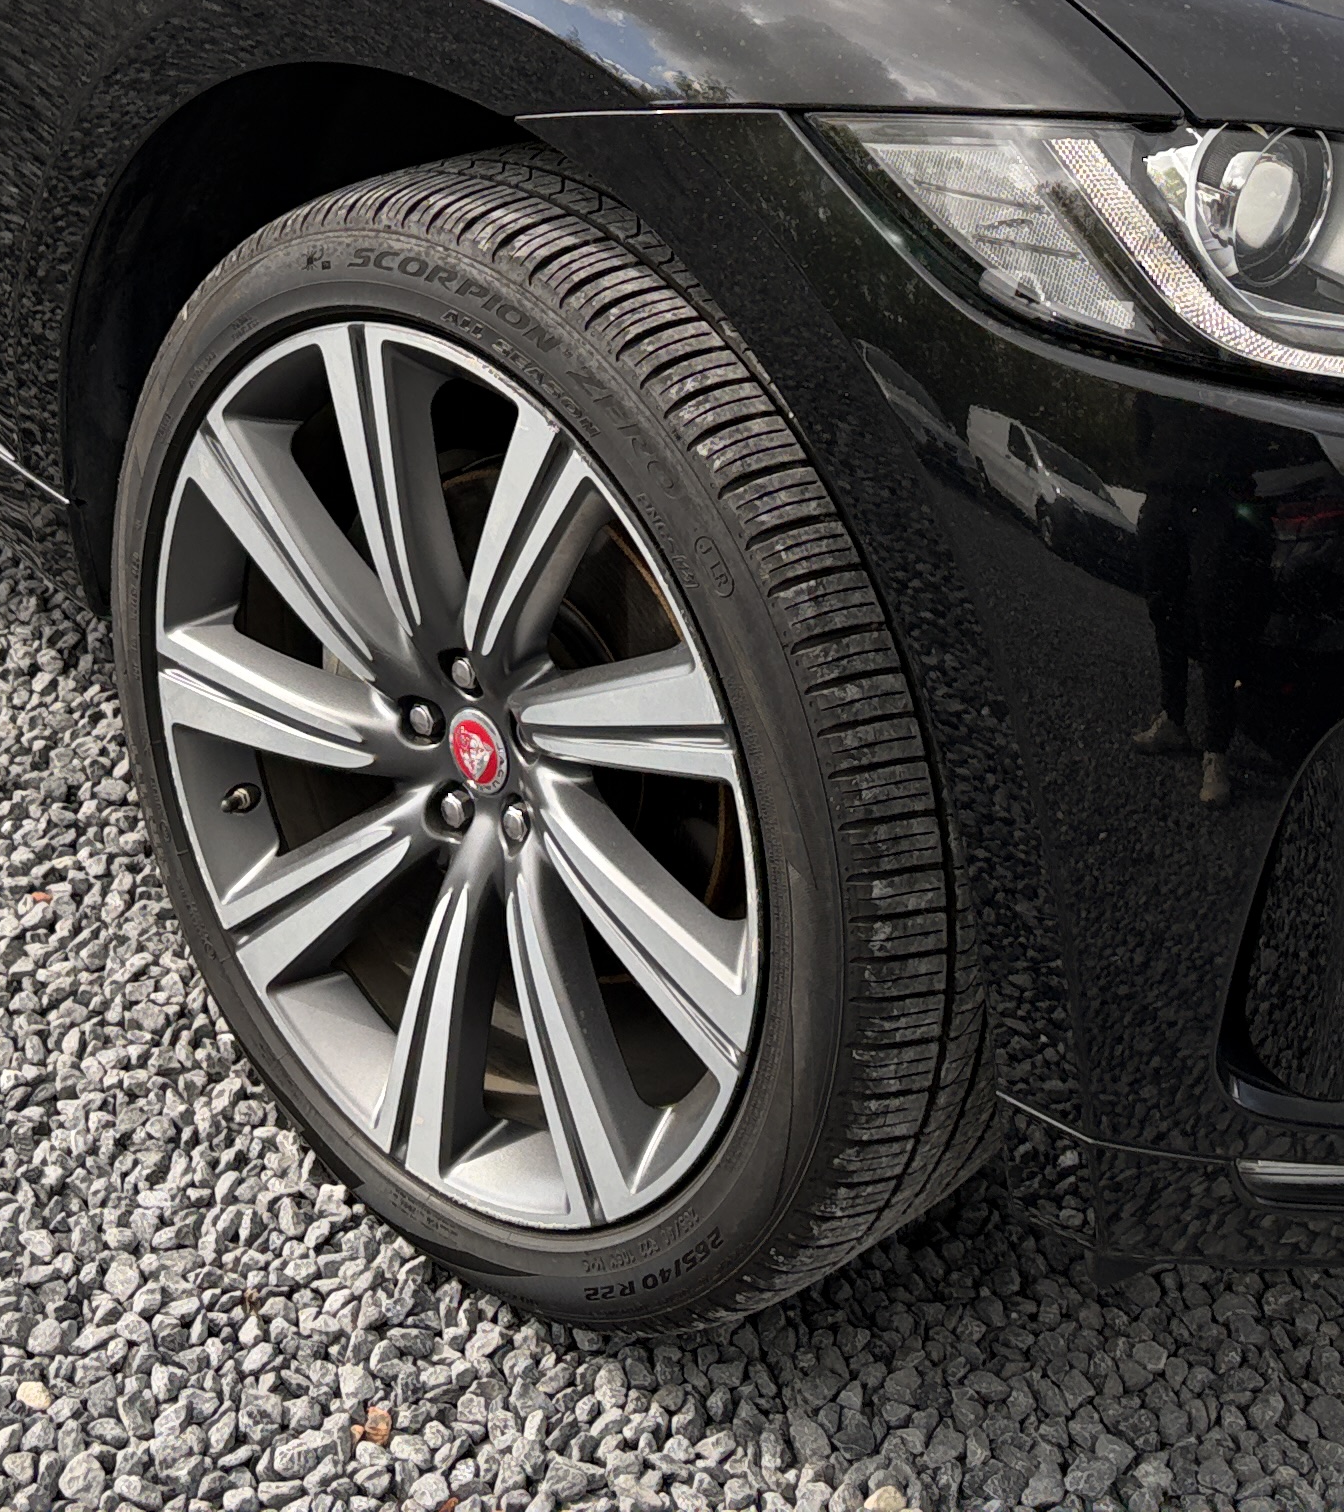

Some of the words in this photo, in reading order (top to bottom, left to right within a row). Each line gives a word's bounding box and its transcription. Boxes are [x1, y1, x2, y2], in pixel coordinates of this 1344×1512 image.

[347, 248, 562, 353] SCORPION
[566, 371, 679, 500] ZERO
[441, 309, 484, 339] ALL
[492, 338, 601, 438] SEASON
[584, 1283, 636, 1302] R22
[642, 1226, 725, 1291] 265/40
